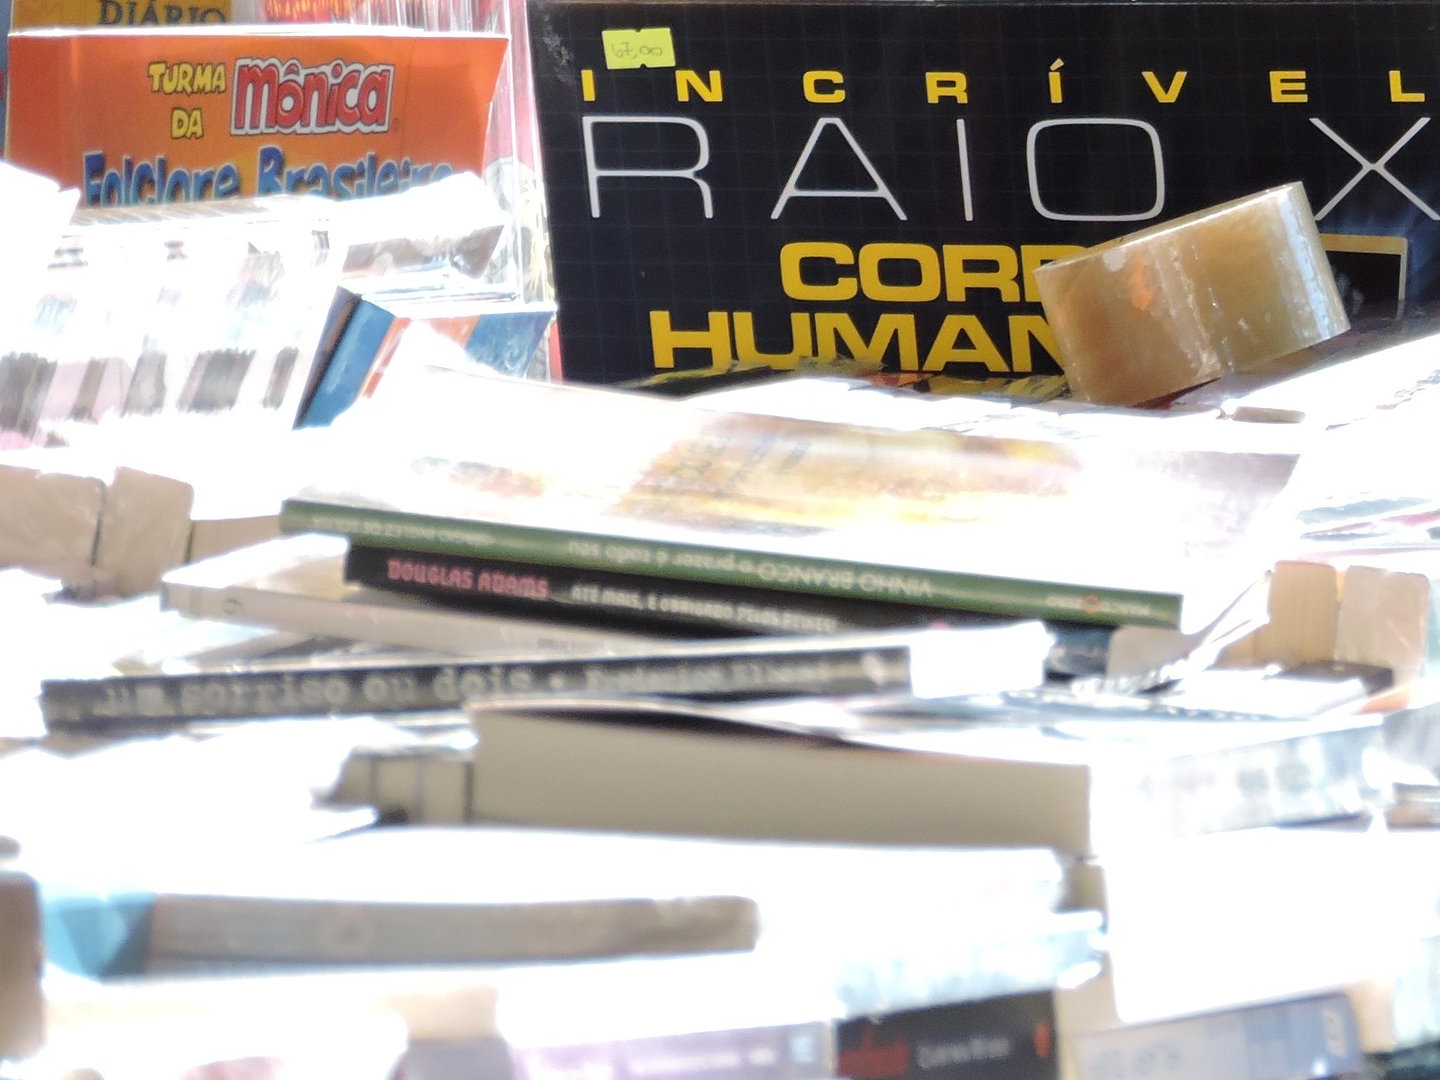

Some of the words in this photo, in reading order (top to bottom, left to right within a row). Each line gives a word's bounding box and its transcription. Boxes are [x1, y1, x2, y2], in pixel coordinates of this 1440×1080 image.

[149, 61, 228, 97] TURMA
[581, 58, 1425, 104] INCRÍVEL
[170, 107, 205, 139] DA
[84, 151, 242, 208] Folclore
[582, 116, 1165, 222] RAIO
[387, 559, 474, 590] DOUGLAS
[477, 571, 549, 600] ADAMS
[571, 582, 598, 603] ATÉ
[758, 560, 854, 588] BRANCO
[858, 573, 933, 597] VINHO
[362, 672, 415, 704] ou
[433, 666, 534, 700] dois
